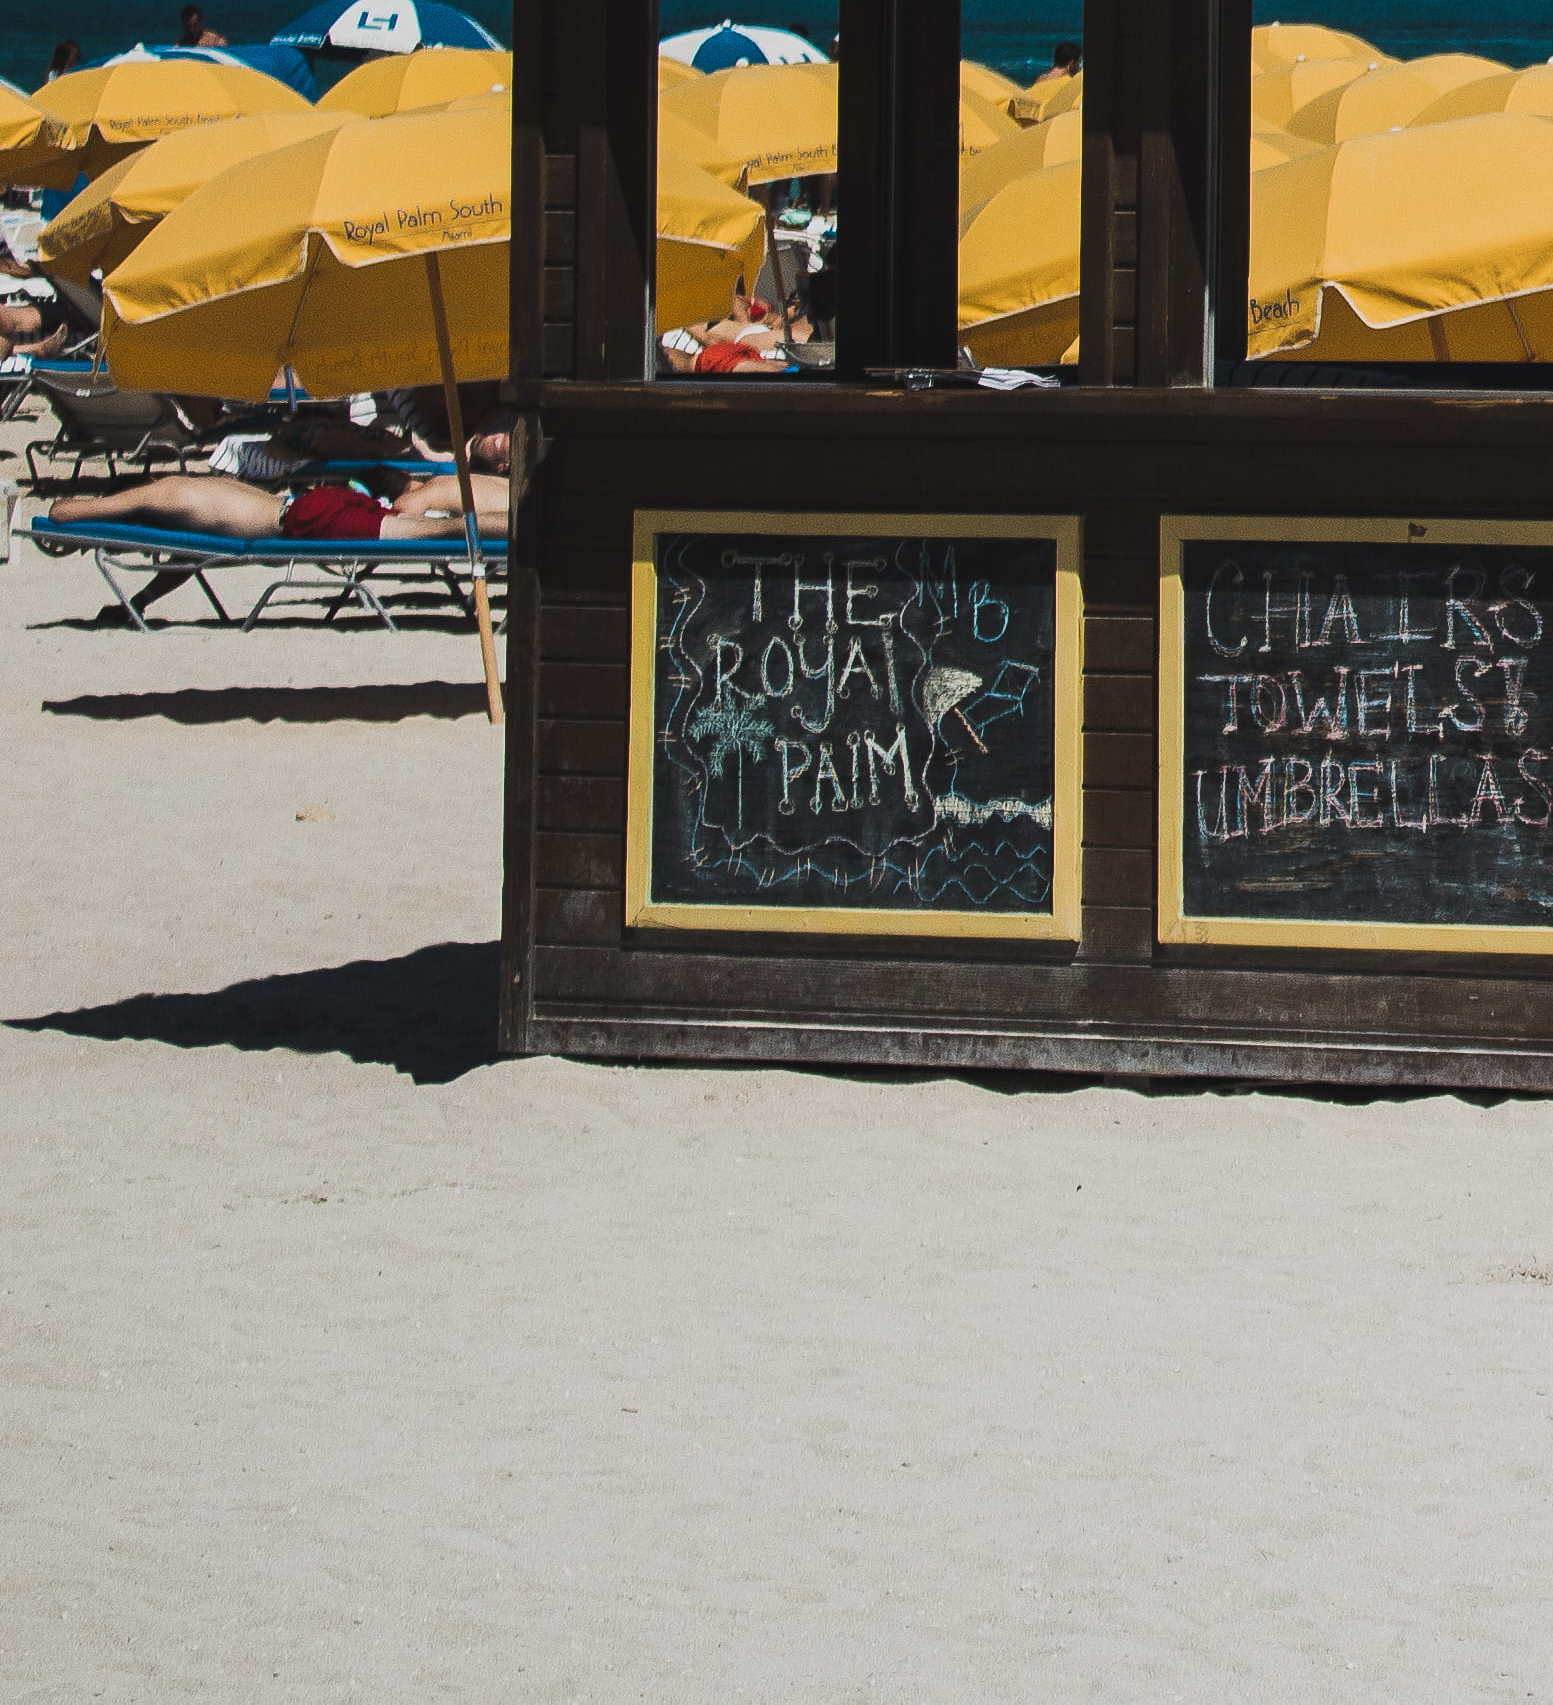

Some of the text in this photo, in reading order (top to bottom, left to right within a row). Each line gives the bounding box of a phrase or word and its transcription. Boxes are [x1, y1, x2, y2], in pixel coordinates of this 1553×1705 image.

[344, 191, 503, 246] Royal Palm South
[1250, 287, 1300, 325] Beach
[721, 550, 894, 633] THE
[1196, 654, 1530, 741] TOWELS!
